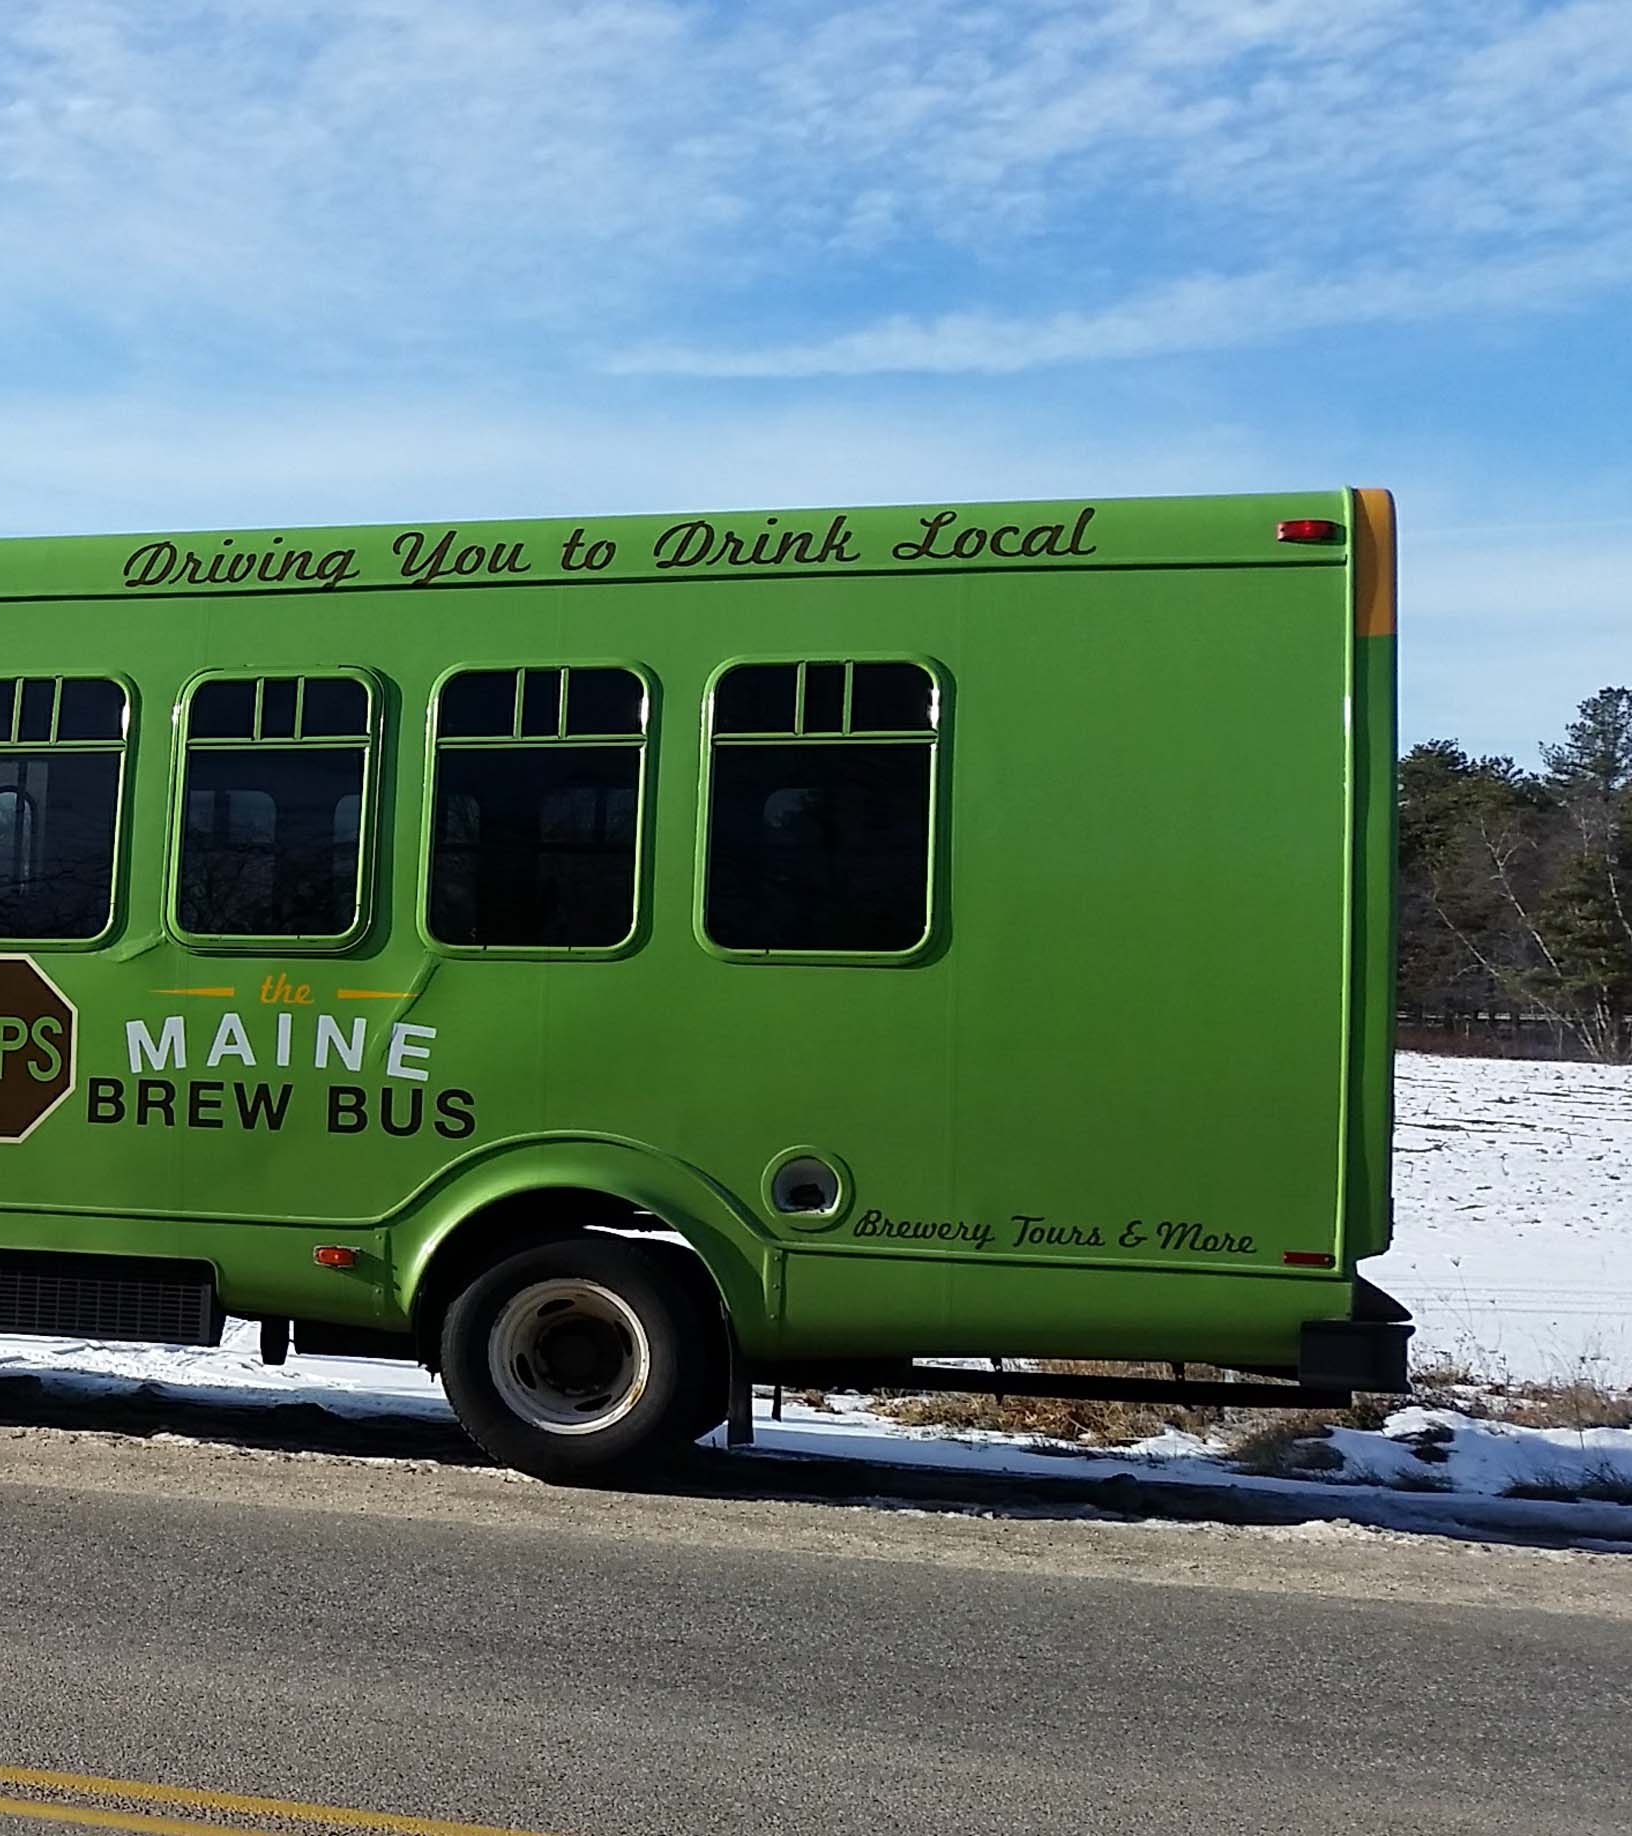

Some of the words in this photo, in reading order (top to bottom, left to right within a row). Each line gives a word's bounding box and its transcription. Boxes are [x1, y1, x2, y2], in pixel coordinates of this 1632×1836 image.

[122, 537, 361, 592] Driving
[392, 529, 531, 586] You
[560, 528, 617, 572] to
[653, 515, 861, 569] Drink
[892, 507, 1097, 561] Local
[260, 972, 315, 1005] the
[124, 1012, 437, 1082] MAINE
[86, 1076, 294, 1132] BREW
[326, 1085, 477, 1140] BUS
[853, 1208, 996, 1250] Brewery
[1011, 1214, 1106, 1249] Tours
[1118, 1219, 1148, 1249] &
[1155, 1219, 1258, 1255] More
